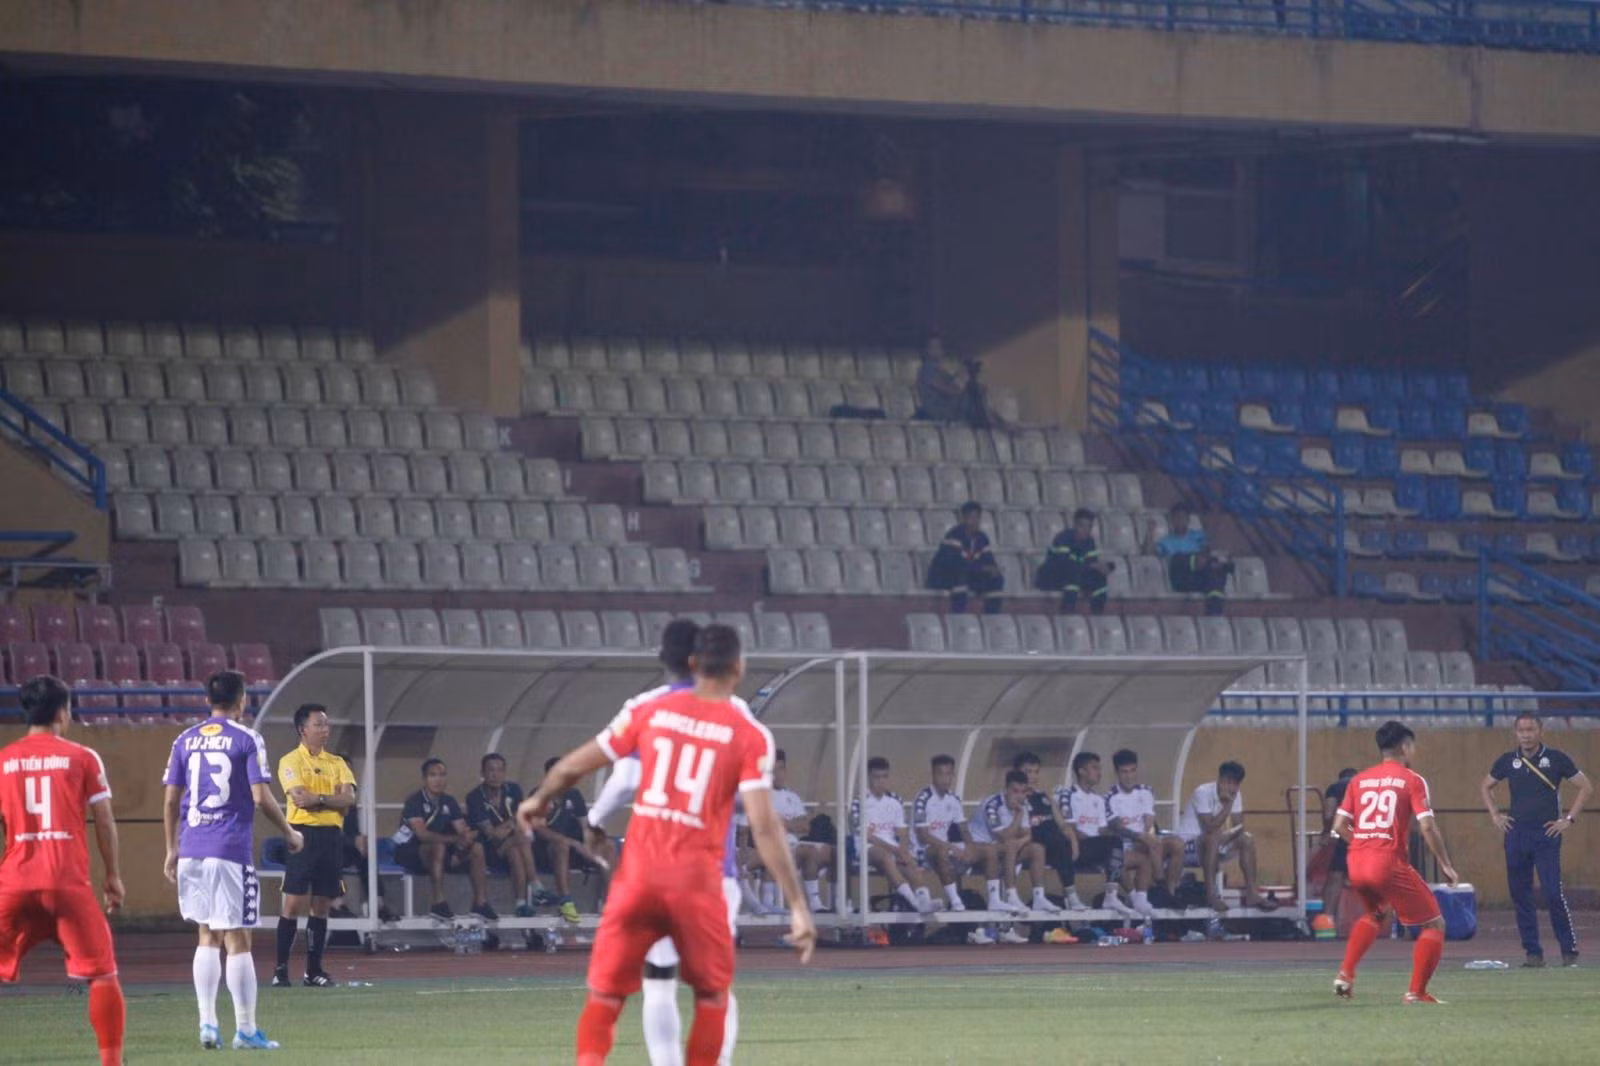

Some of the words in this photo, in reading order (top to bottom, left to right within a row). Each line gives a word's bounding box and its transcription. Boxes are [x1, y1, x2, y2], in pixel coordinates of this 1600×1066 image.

[499, 426, 512, 446] K
[627, 511, 640, 531] H
[188, 751, 233, 809] 13
[641, 736, 717, 814] 14
[24, 775, 51, 830] 4
[1358, 790, 1398, 829] 29
